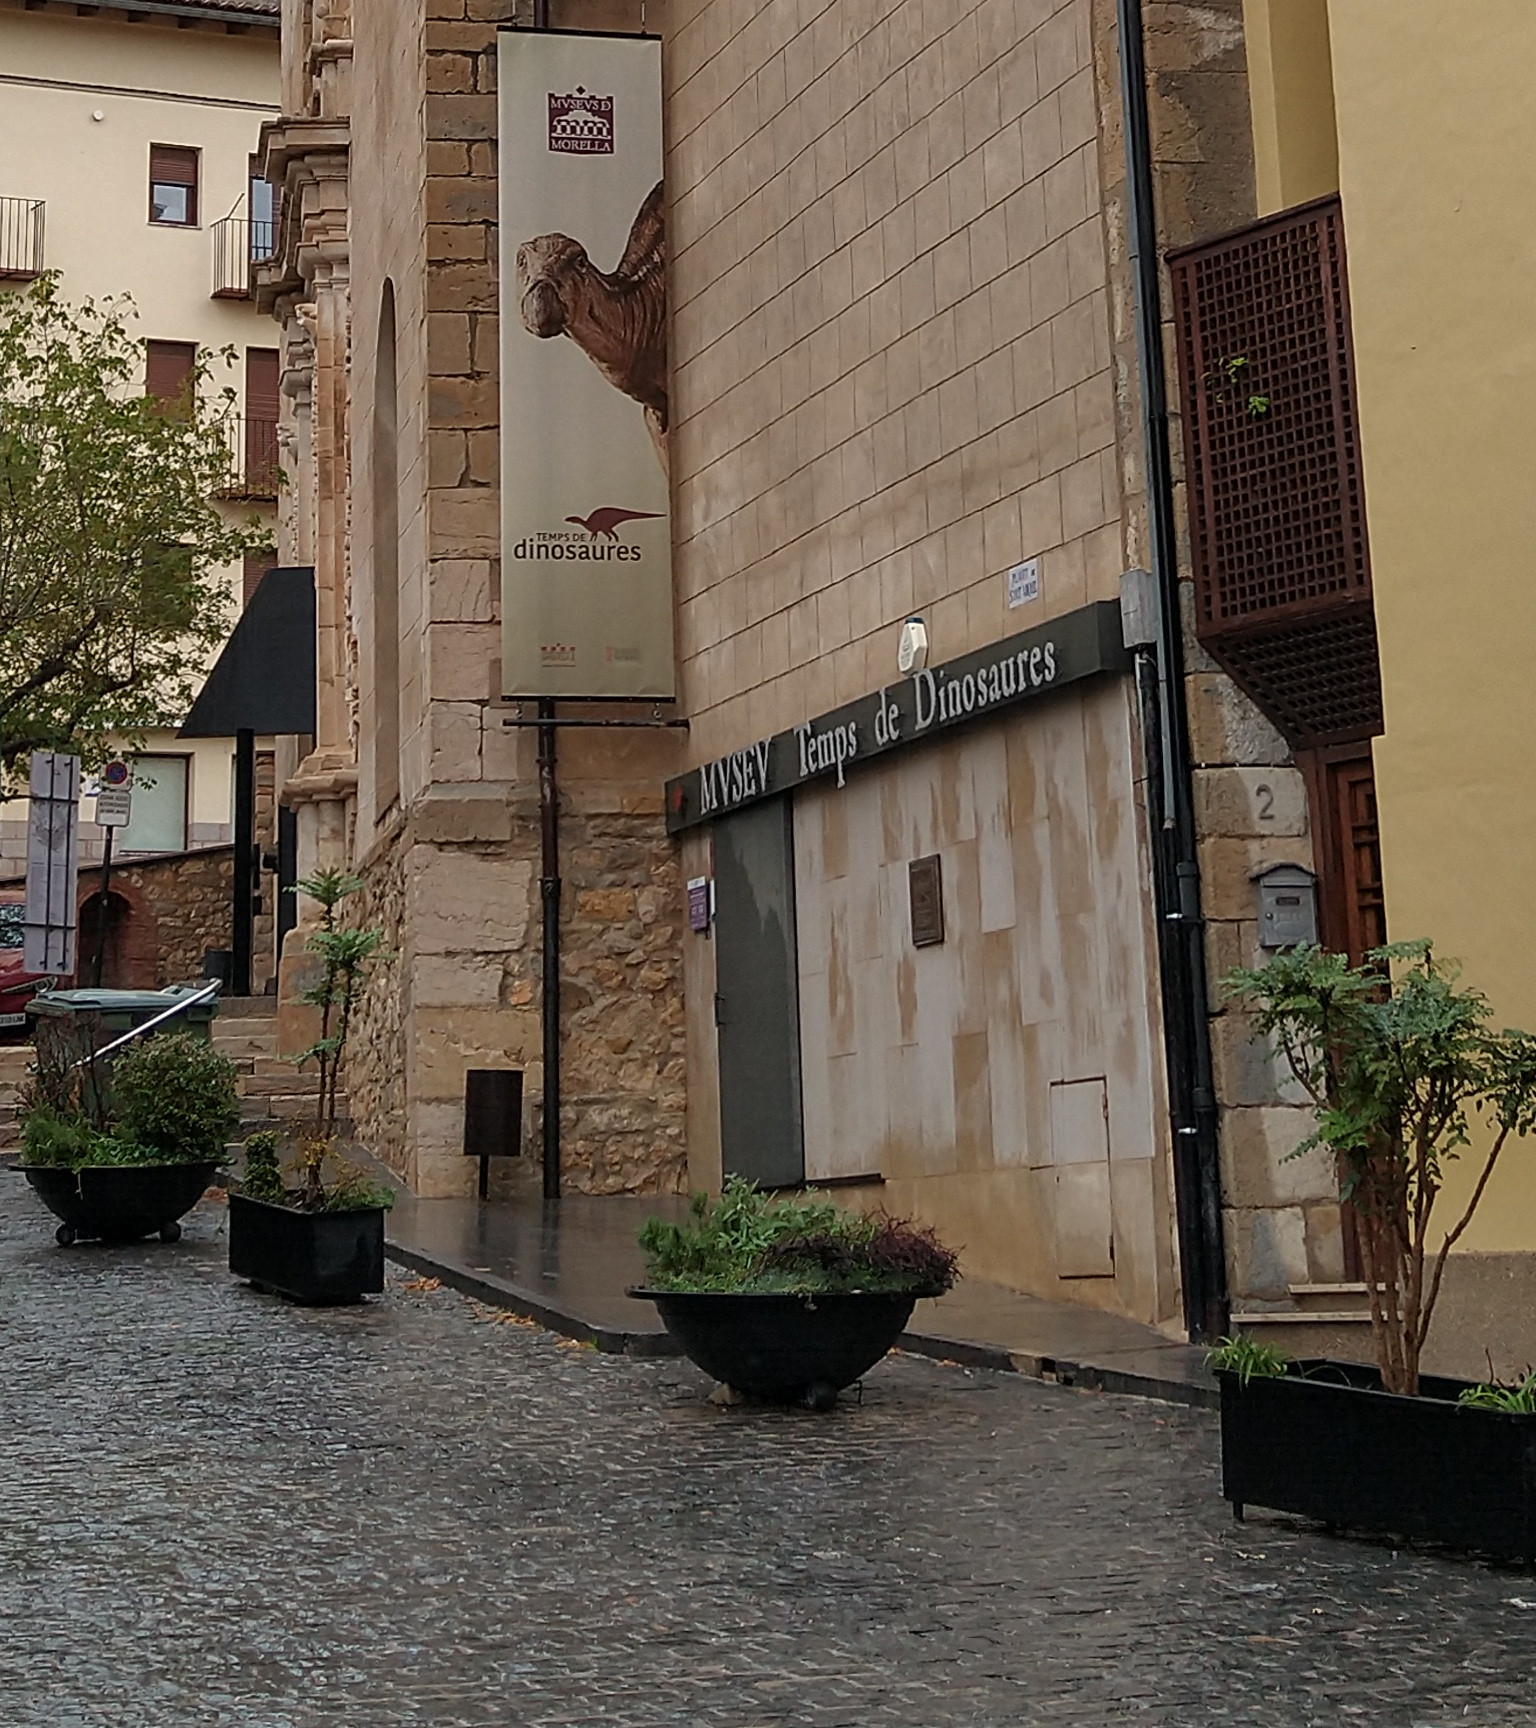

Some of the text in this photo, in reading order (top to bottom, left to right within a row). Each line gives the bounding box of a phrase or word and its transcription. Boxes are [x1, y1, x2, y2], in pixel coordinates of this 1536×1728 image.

[551, 139, 611, 152] MORELLA
[536, 533, 586, 542] TEMPS DE
[513, 538, 642, 561] dinosaures
[699, 641, 1056, 815] MVSEV Temps de Dinosaures
[1255, 783, 1274, 820] 2
